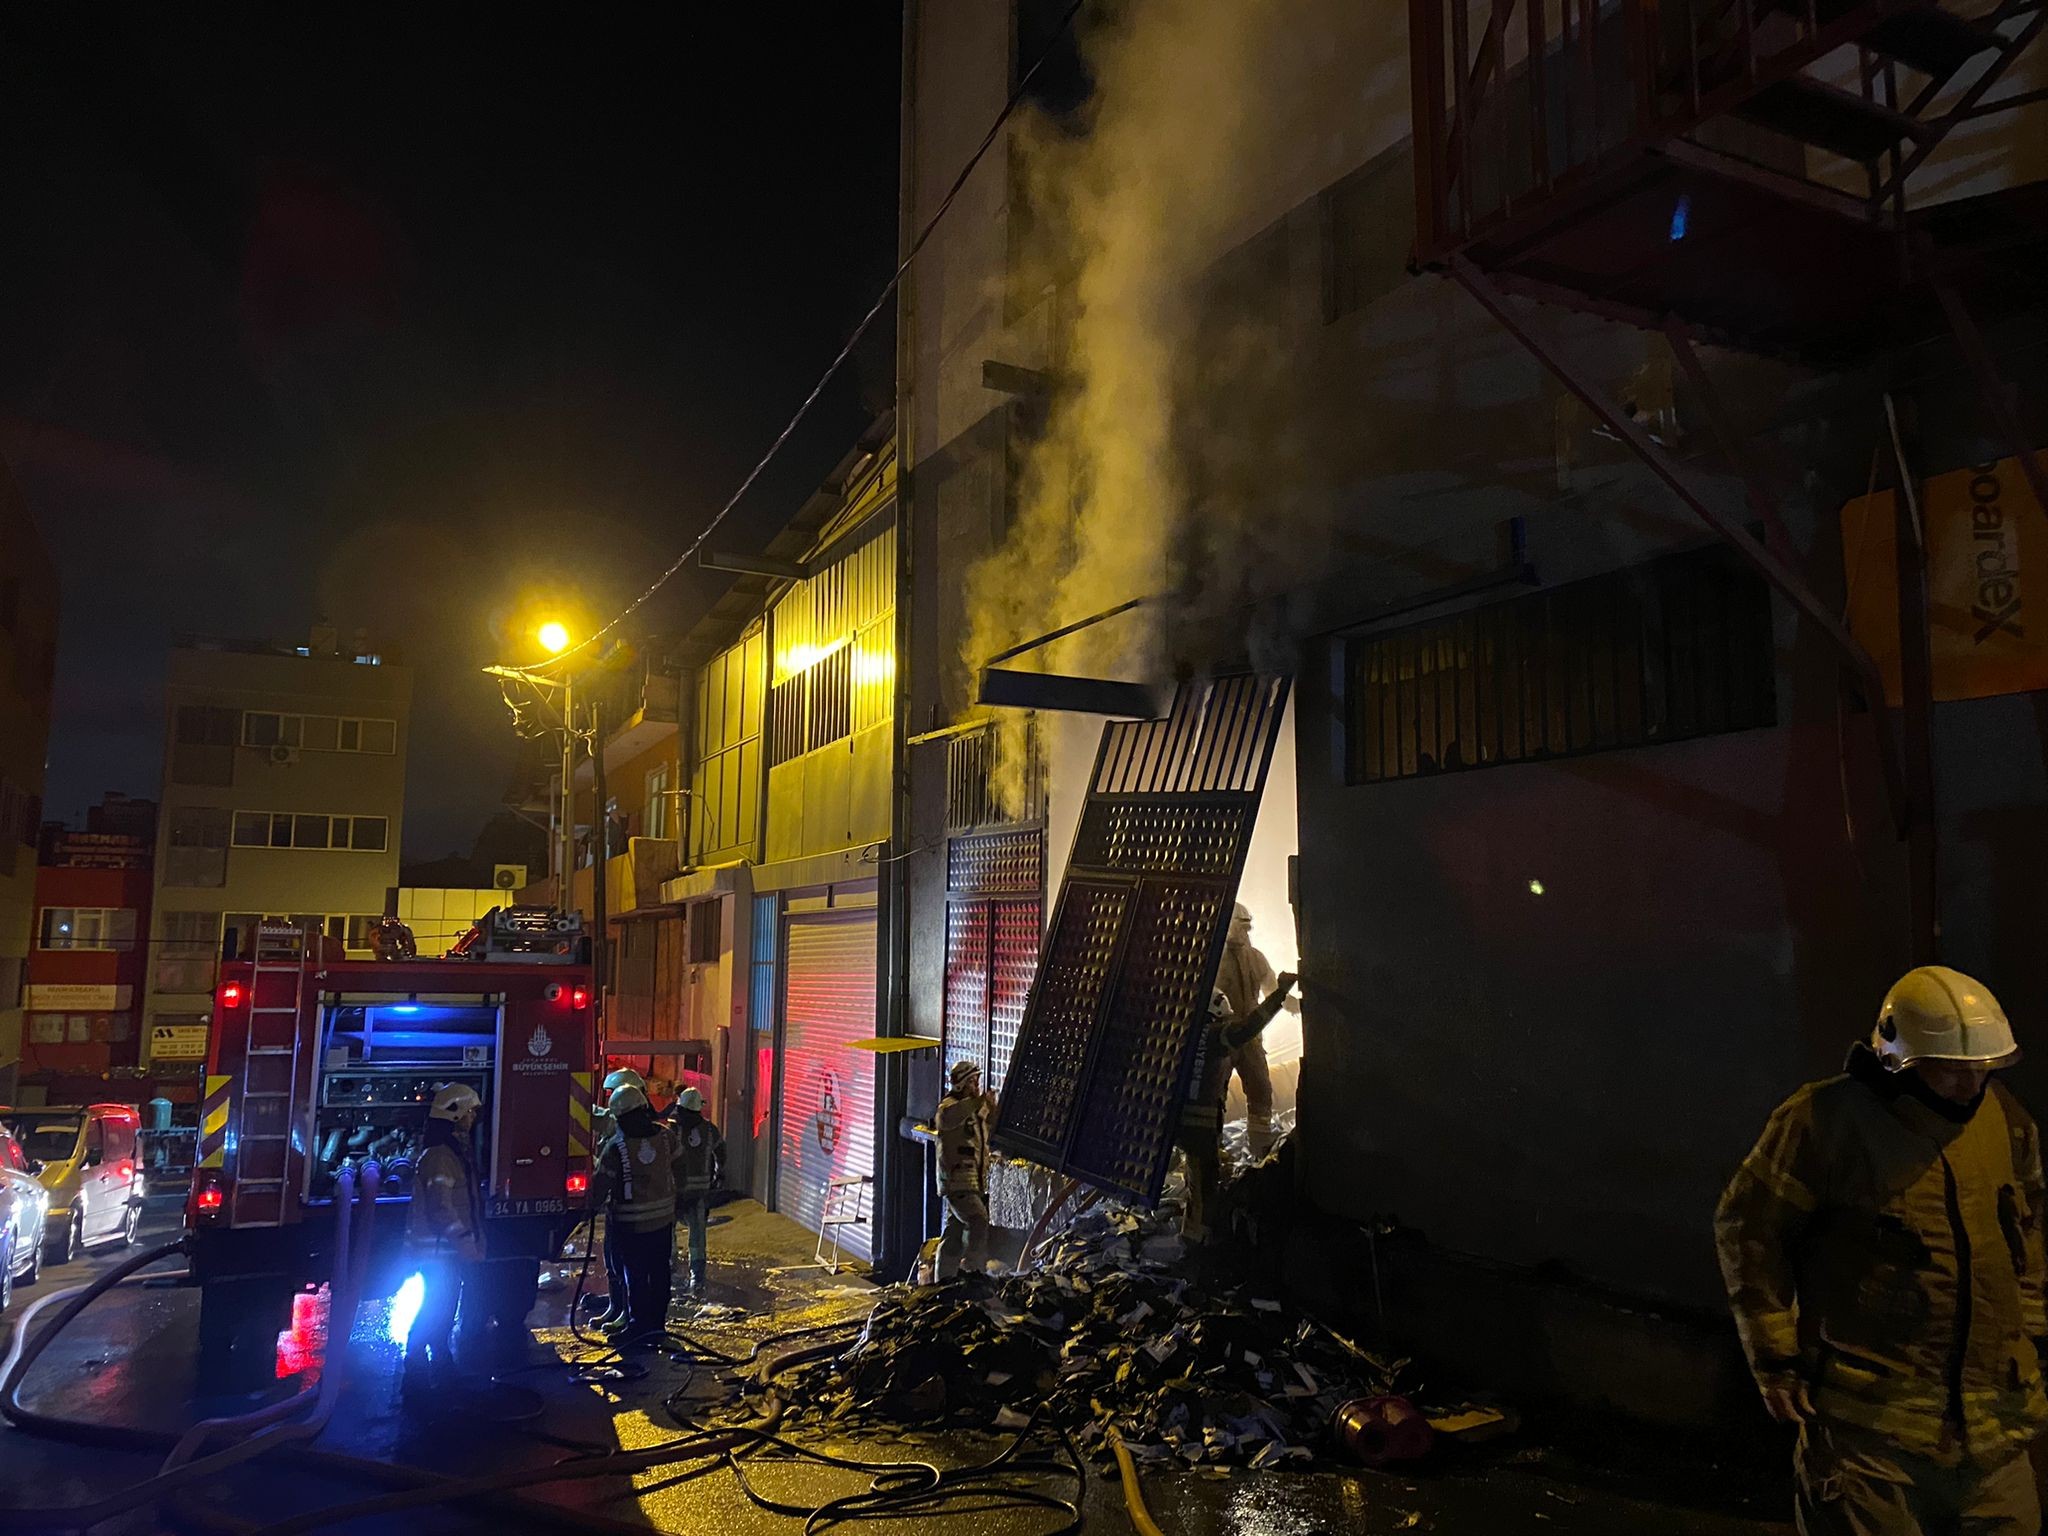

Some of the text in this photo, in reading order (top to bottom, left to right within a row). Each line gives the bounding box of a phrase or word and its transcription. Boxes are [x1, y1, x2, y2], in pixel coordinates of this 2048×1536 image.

[495, 1200, 564, 1215] 34 YA 0965
